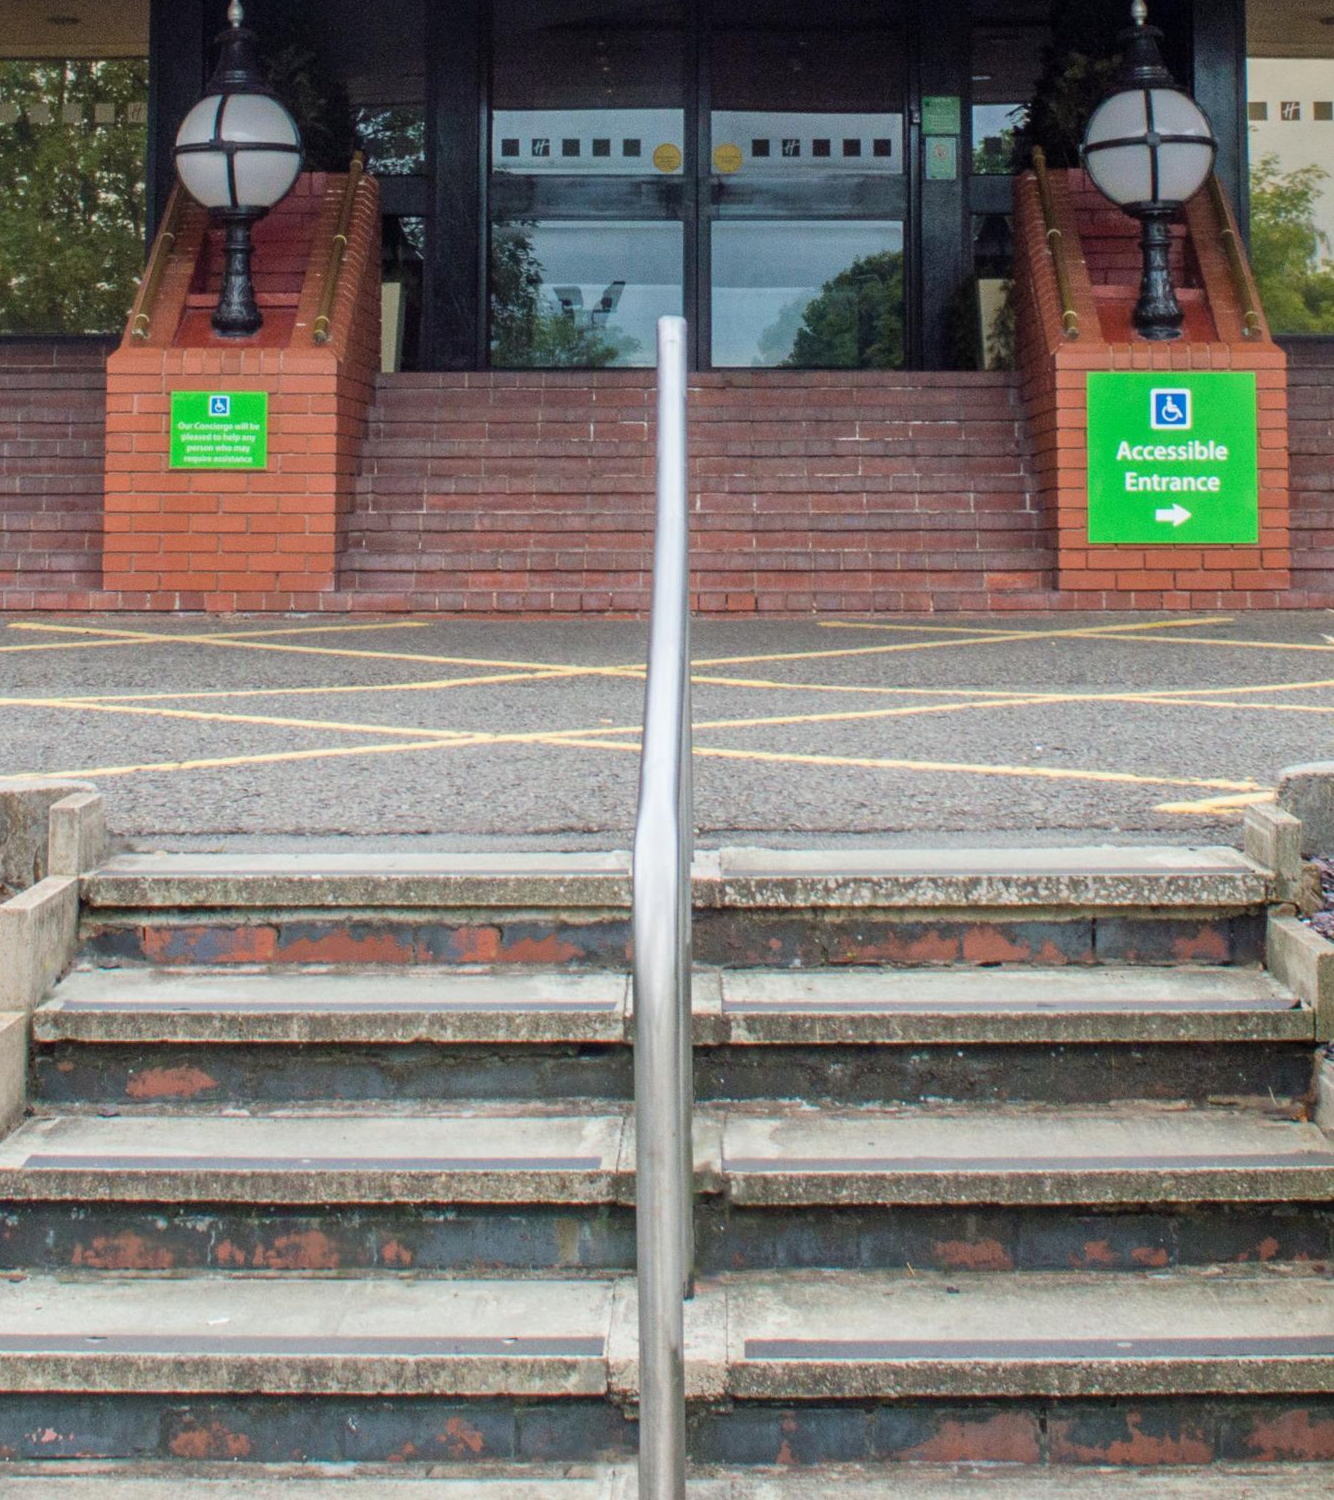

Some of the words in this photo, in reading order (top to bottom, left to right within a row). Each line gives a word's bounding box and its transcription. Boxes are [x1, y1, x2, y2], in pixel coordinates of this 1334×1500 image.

[177, 422, 192, 430] Our
[194, 422, 233, 432] Concierge
[234, 422, 249, 430] will
[250, 422, 260, 430] be
[181, 433, 212, 443] pleased
[213, 434, 222, 442] to
[223, 433, 241, 443] help
[241, 435, 256, 443] any
[187, 445, 214, 453] person
[215, 444, 233, 452] who
[233, 445, 251, 453] may
[1116, 440, 1228, 461] Accessible
[183, 456, 212, 464] require
[1124, 471, 1221, 492] Entrance
